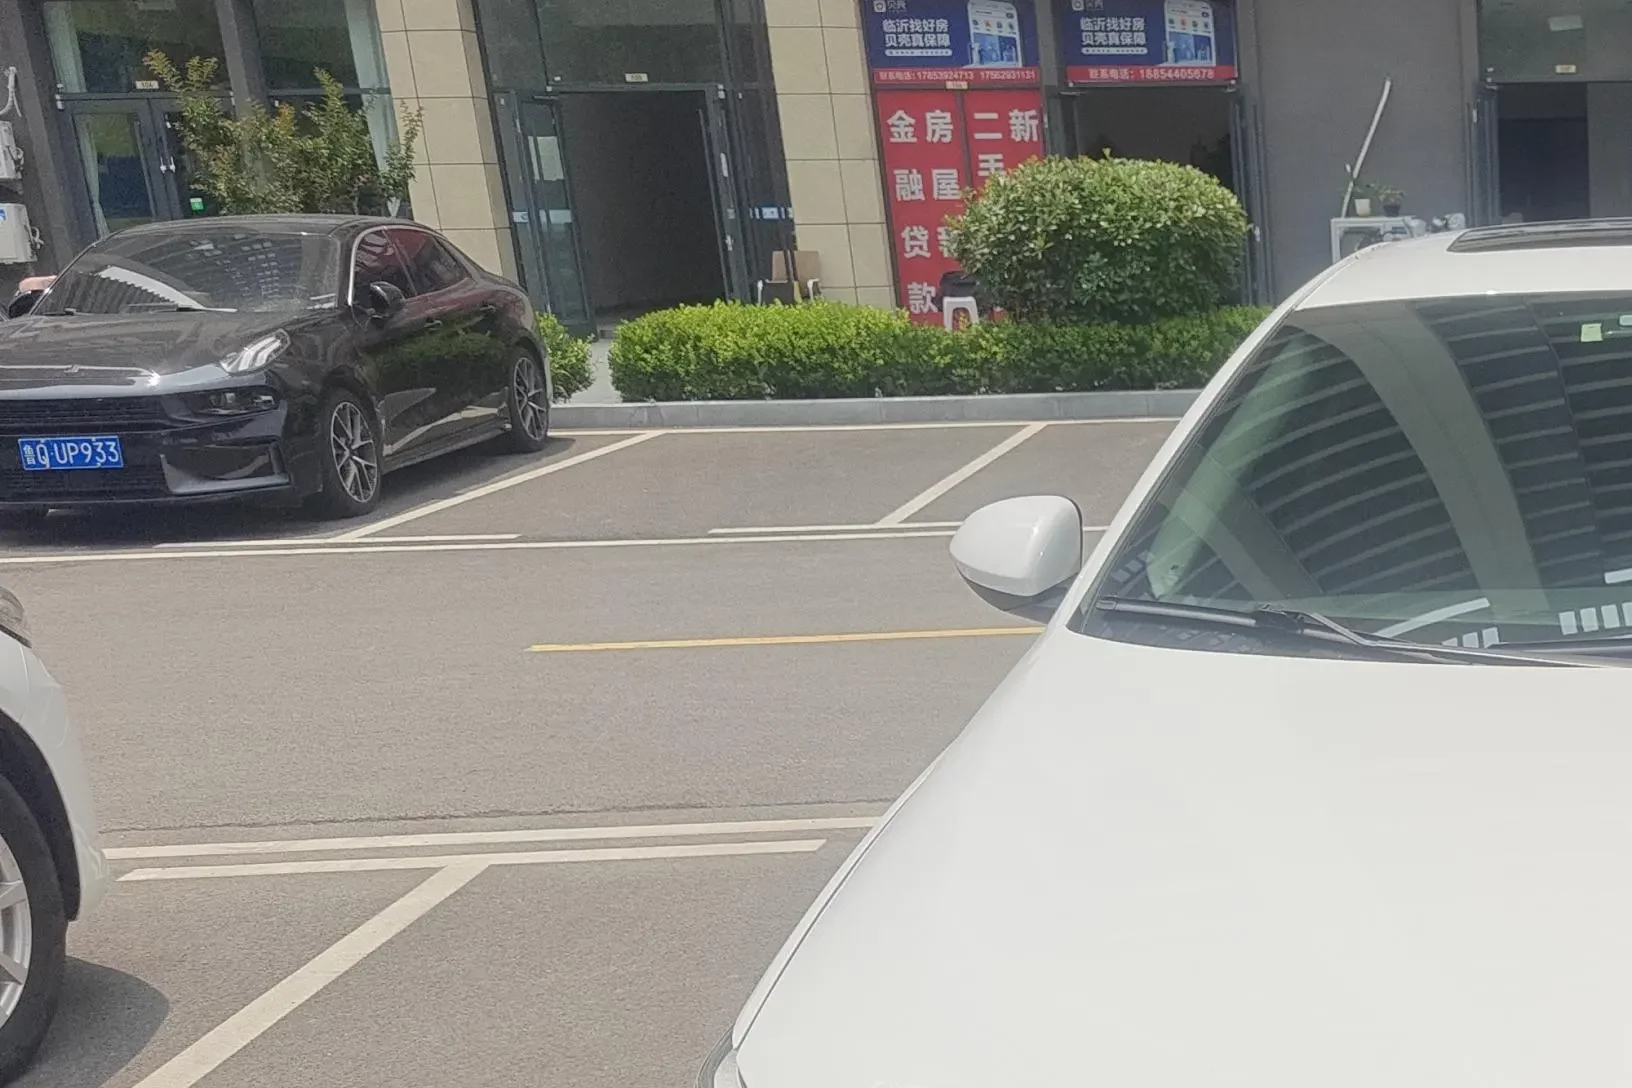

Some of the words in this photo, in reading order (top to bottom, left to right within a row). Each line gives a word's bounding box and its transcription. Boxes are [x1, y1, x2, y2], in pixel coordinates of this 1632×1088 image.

[882, 18, 949, 33] 临沂找好房
[1080, 17, 1145, 31] 临沂找好房
[884, 33, 951, 47] 贝壳真保障
[1081, 31, 1147, 46] 贝壳真保障
[1008, 109, 1039, 143] 新
[887, 109, 939, 315] 金融贷款
